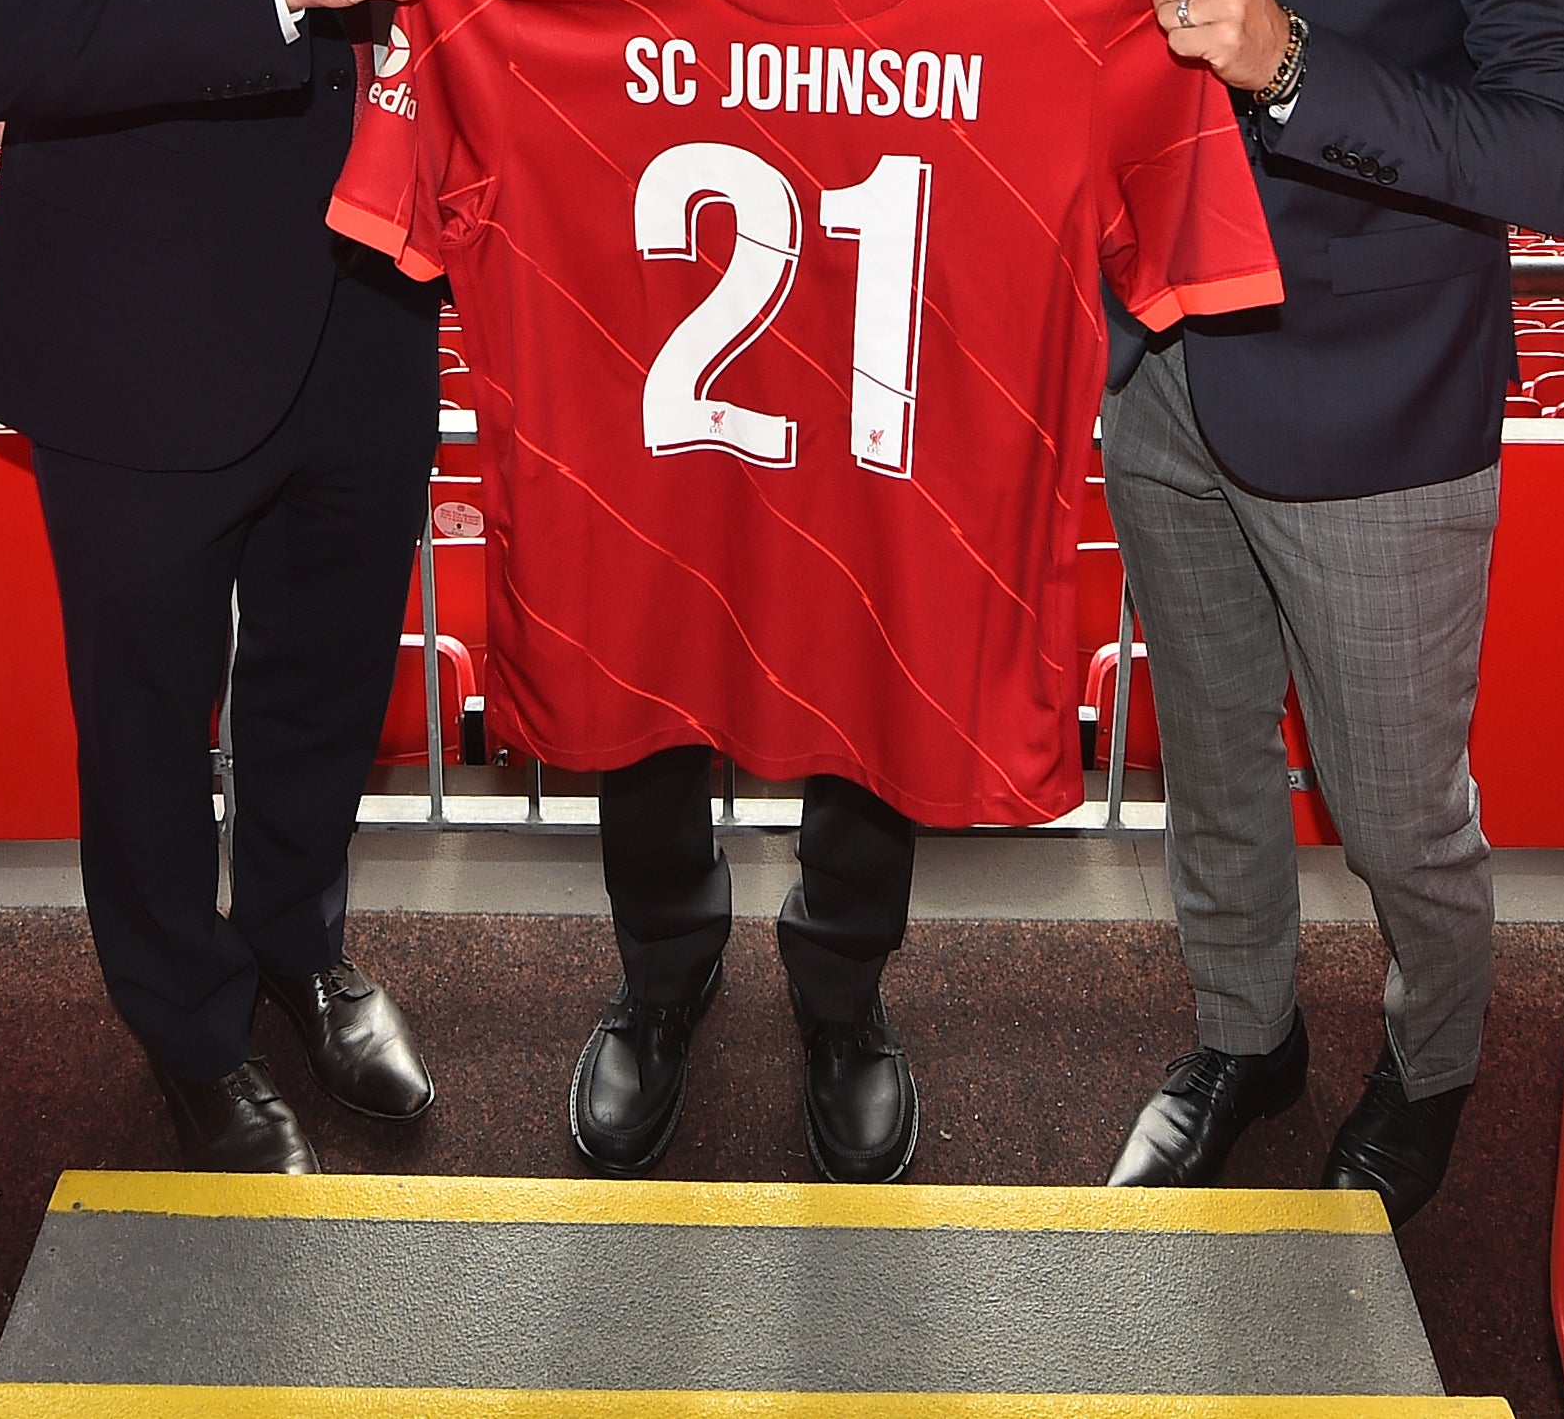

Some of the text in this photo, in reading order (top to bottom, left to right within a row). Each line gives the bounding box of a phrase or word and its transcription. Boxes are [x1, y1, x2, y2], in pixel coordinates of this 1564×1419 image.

[624, 36, 983, 121] SC JOHNSON
[633, 142, 933, 480] 21
